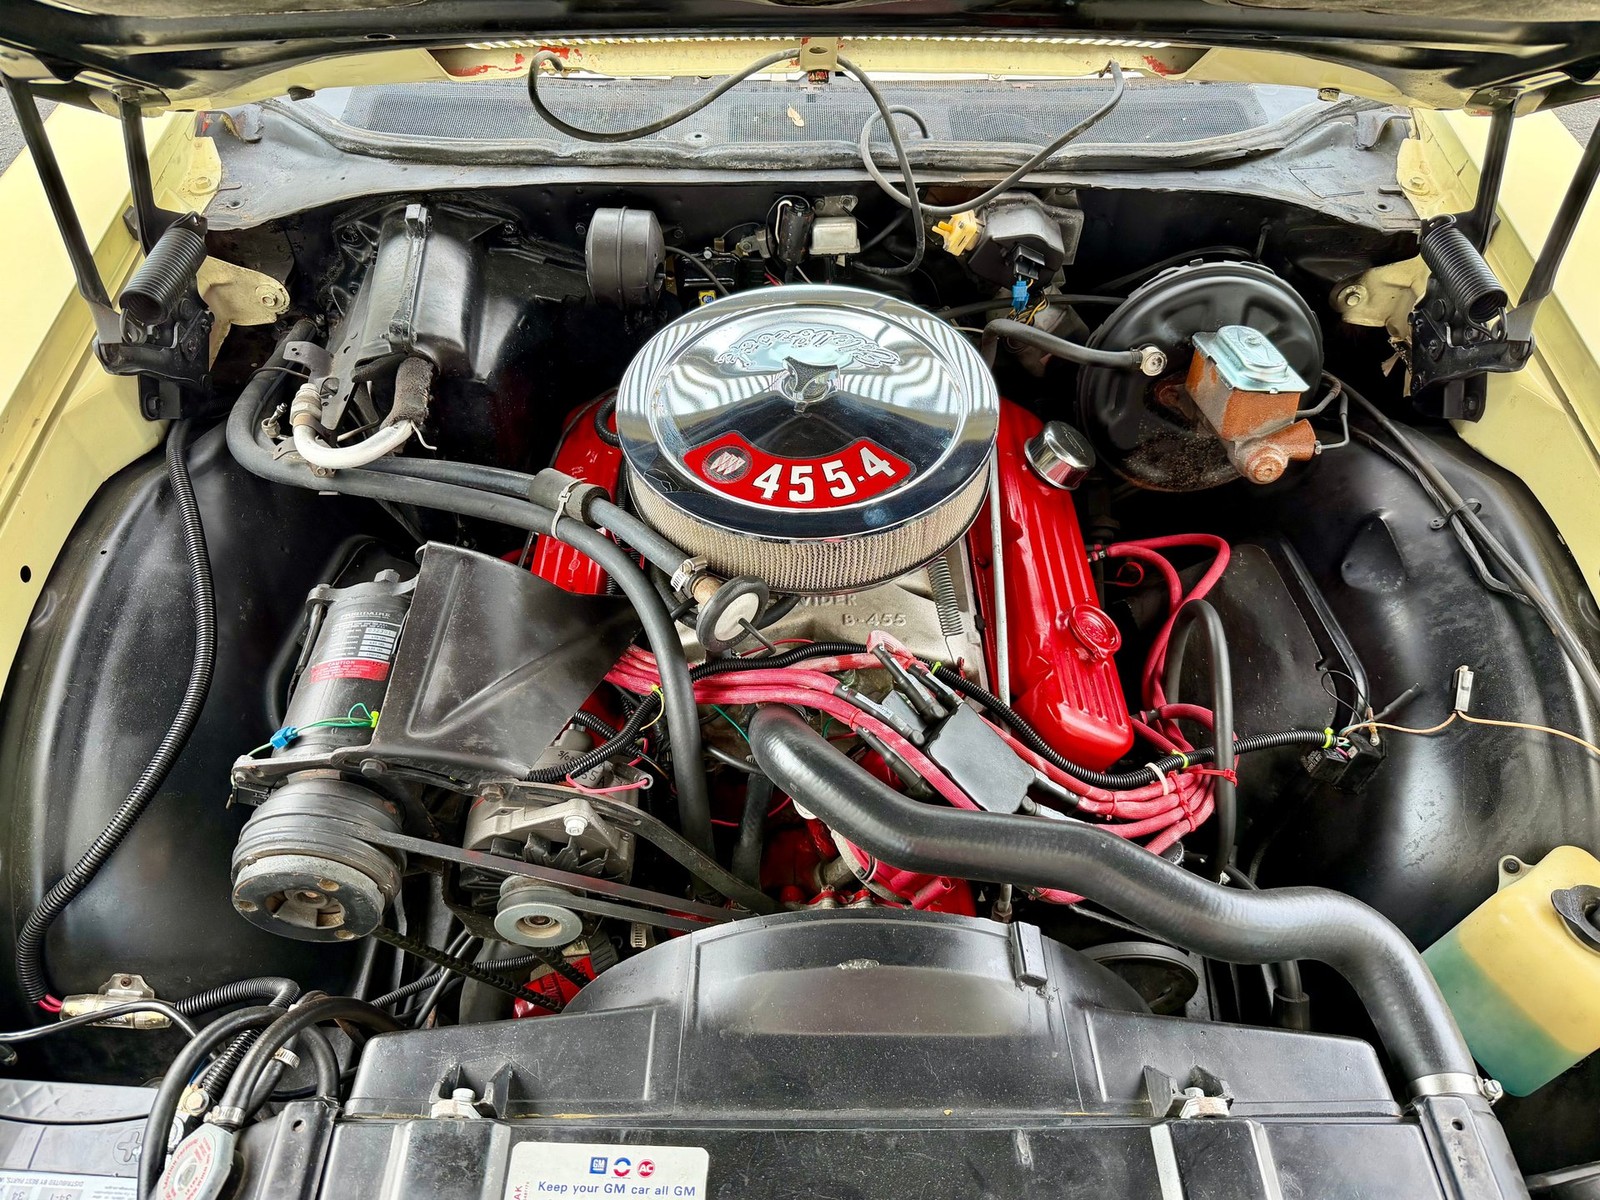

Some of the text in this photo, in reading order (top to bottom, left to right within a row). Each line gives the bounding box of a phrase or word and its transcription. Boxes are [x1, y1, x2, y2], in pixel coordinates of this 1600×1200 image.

[592, 1158, 606, 1169] GM
[638, 1163, 653, 1173] AC
[538, 1181, 568, 1194] Keep
[573, 1184, 600, 1195] your
[604, 1183, 626, 1194] GM
[631, 1186, 649, 1195] car
[654, 1185, 669, 1195] all
[674, 1186, 696, 1197] GM
